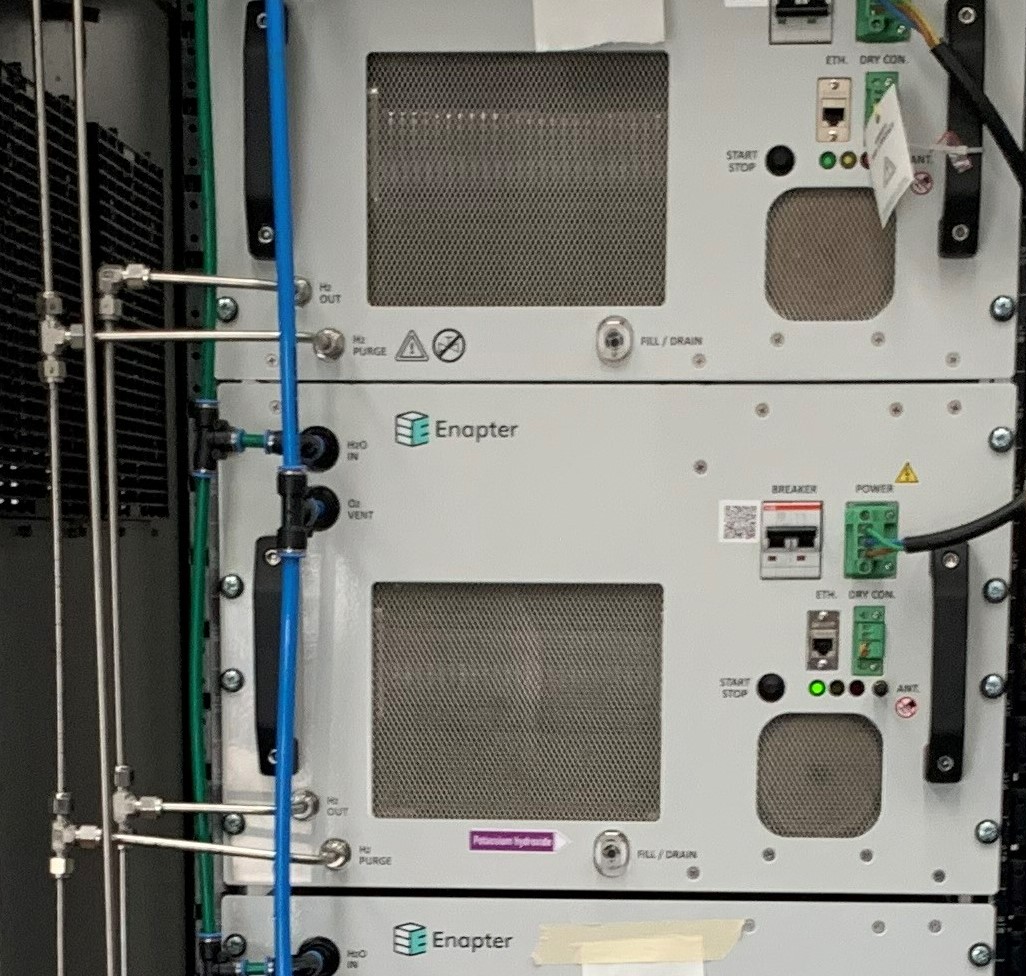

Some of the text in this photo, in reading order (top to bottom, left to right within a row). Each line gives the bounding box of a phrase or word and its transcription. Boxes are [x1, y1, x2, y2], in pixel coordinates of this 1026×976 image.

[859, 55, 881, 65] DRY
[726, 150, 758, 160] START
[728, 162, 756, 173] STOP
[319, 294, 341, 304] OUT
[640, 336, 659, 346] FILL
[669, 336, 703, 346] DRAIN
[352, 346, 387, 357] PURGE
[435, 420, 519, 443] Enapter
[347, 451, 359, 461] IN
[771, 484, 818, 495] BREAKER
[855, 484, 894, 495] POWER
[347, 510, 374, 520] VENT
[848, 590, 869, 599] DRY
[719, 678, 751, 687] START
[722, 689, 748, 699] STOP
[327, 807, 348, 817] OUT
[359, 856, 392, 866] PURGE
[432, 931, 513, 953] Enapter
